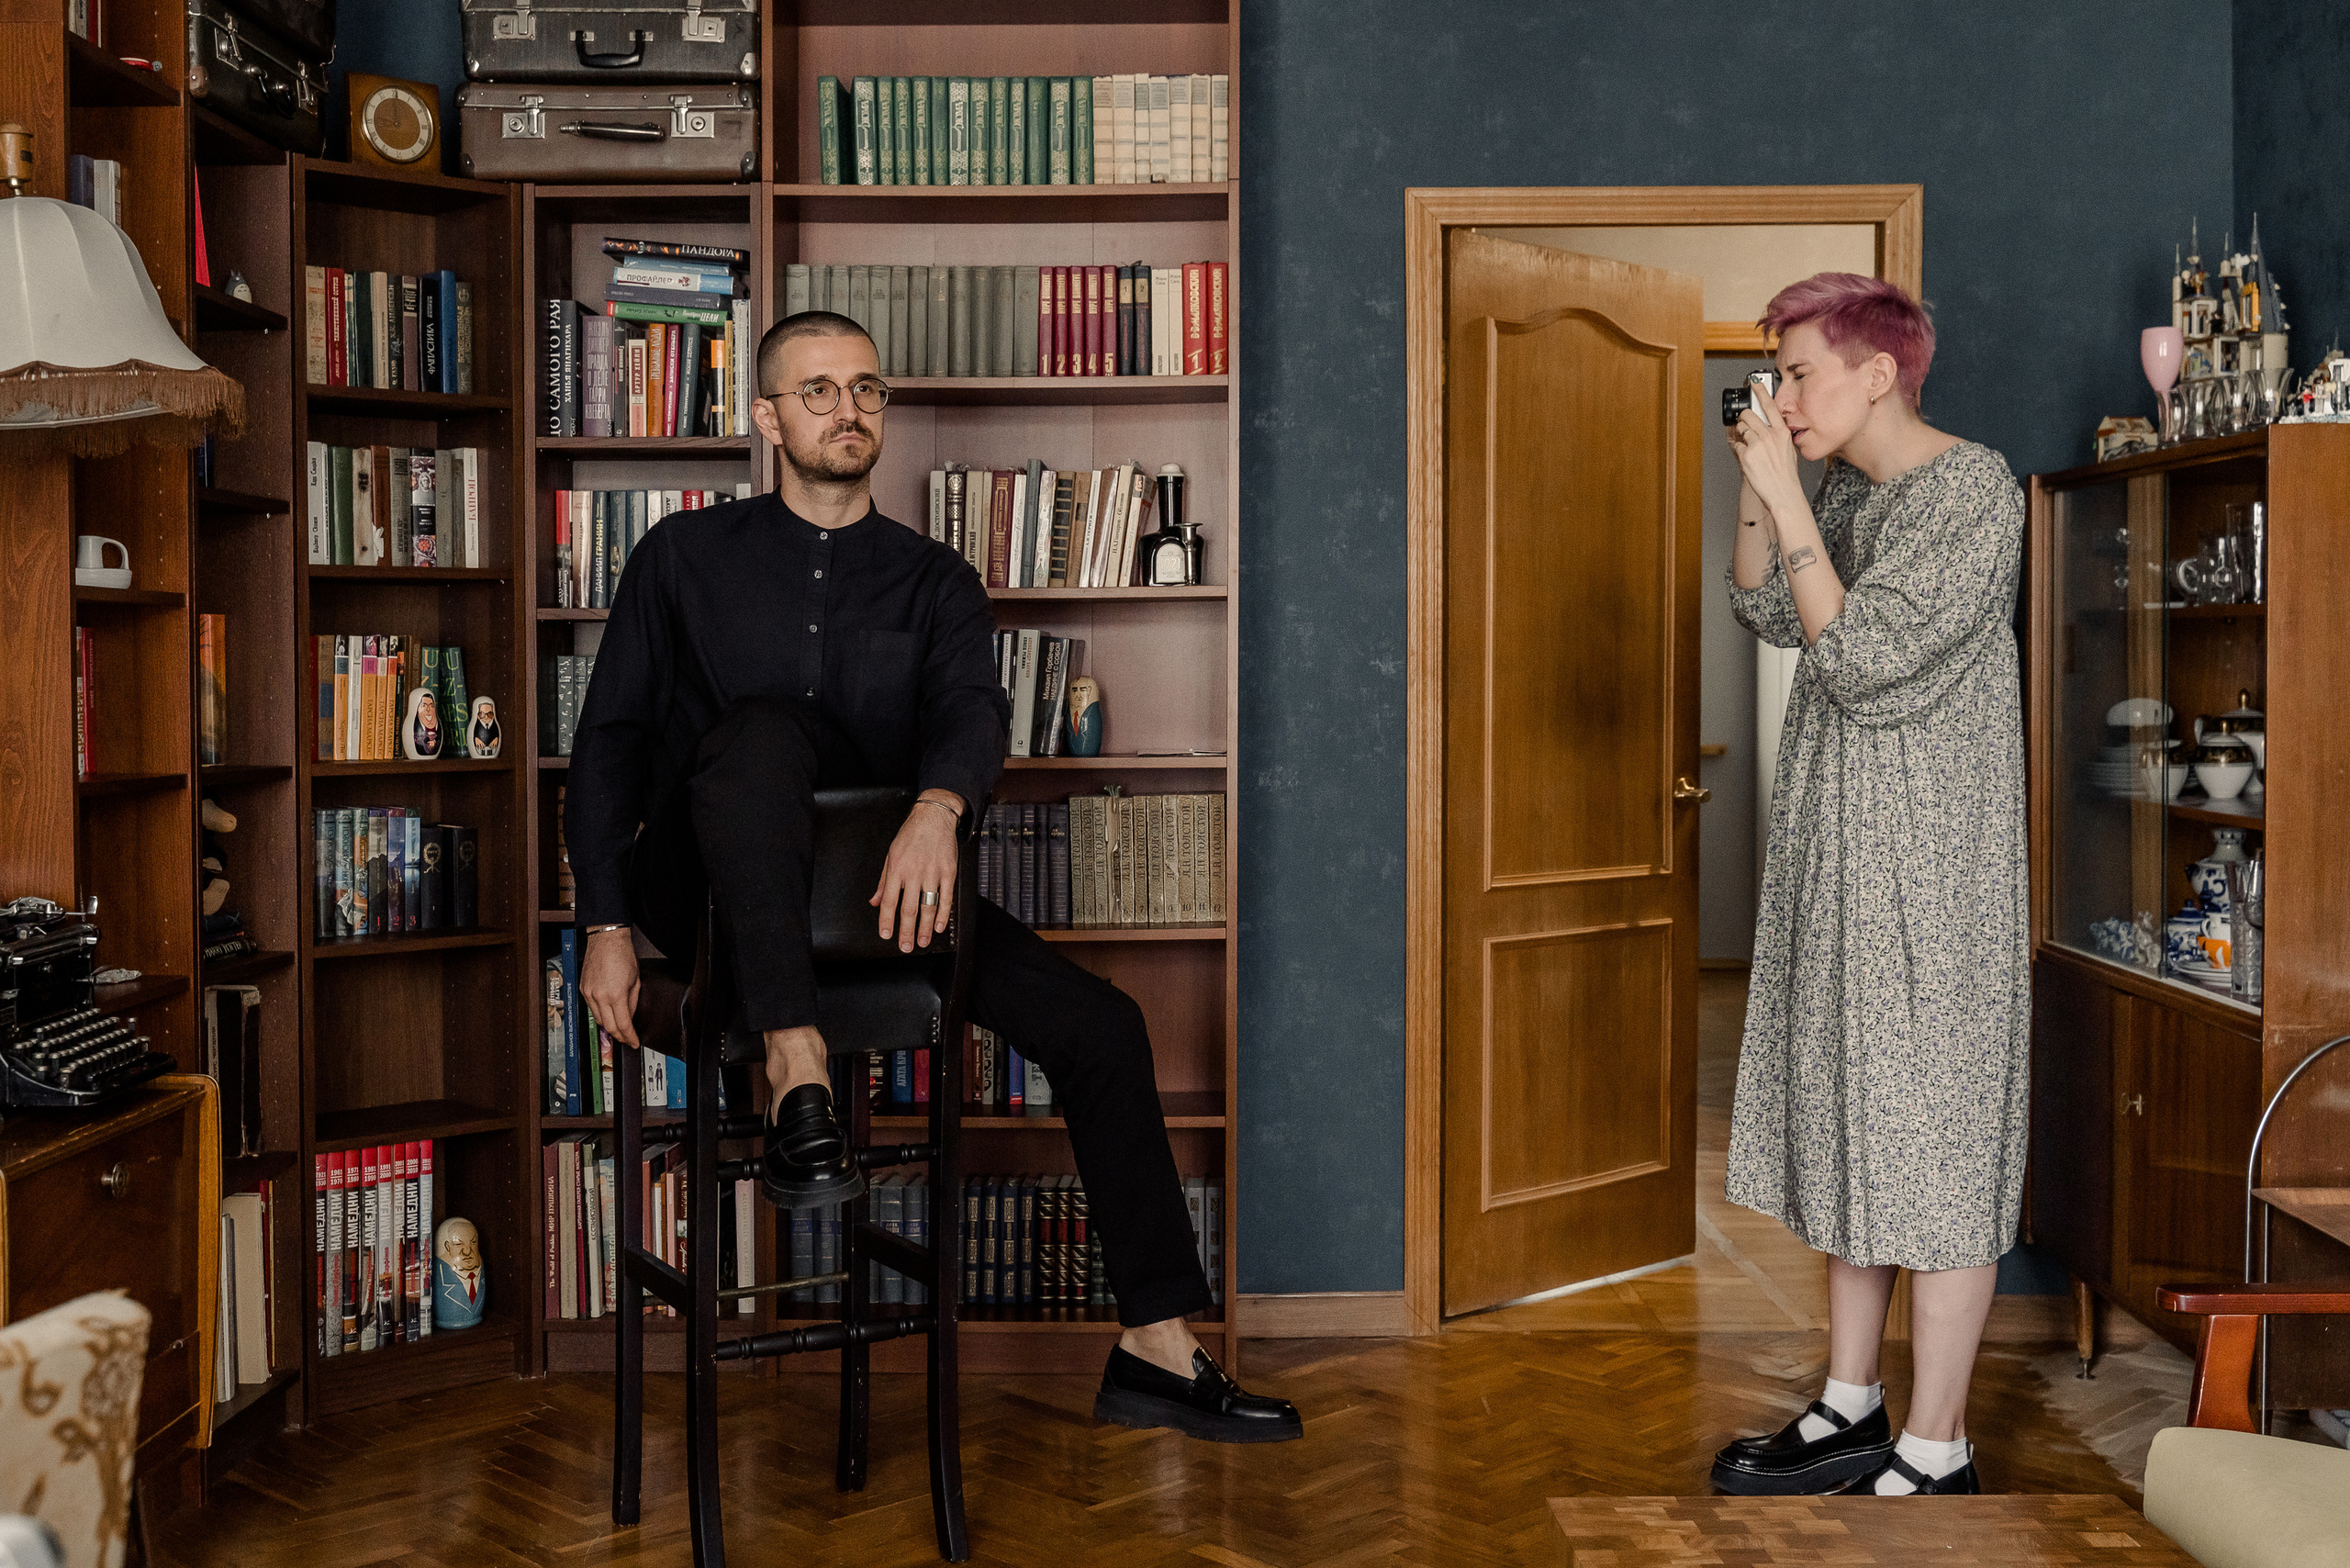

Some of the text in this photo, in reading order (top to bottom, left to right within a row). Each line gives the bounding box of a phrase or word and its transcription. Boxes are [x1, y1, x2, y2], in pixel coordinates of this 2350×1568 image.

[681, 245, 734, 259] ПАНДОРА
[627, 274, 673, 286] ПРОФАЙЛЕР
[550, 298, 561, 330] РАЯ
[699, 311, 720, 324] ЦЕЛИ
[426, 323, 436, 375] ФАНТАСТИКА
[650, 329, 661, 380] ТРЕВОЖНЫЕ ЛЮДИ
[550, 335, 561, 410] САМОГО
[633, 348, 643, 394] АРТУР ХЕЙЛИ
[1042, 354, 1048, 375] 1
[1057, 354, 1066, 375] 2
[1072, 353, 1081, 374] 3
[1088, 353, 1097, 374] 4
[1104, 353, 1113, 370] 5
[588, 387, 607, 402] ГАРРИ
[586, 405, 610, 420] КВЕБЕРТА
[467, 479, 476, 521] БАЙРОН
[1116, 493, 1125, 515] Обломов
[595, 519, 604, 593] ДАНИИЛ ГРАНИН
[1043, 673, 1051, 700] Михаил
[365, 699, 374, 756] ГАРСИА МАРКЕС
[386, 727, 395, 756] МАРКЕС
[409, 915, 417, 926] 3
[222, 940, 242, 954] POTTER
[896, 1066, 907, 1087] АГАТА
[347, 1175, 359, 1183] 1980
[364, 1174, 376, 1182] 1990
[606, 1169, 615, 1197] ДЕТЕЙ
[347, 1191, 359, 1248] НАМЕДНИ
[364, 1189, 377, 1247] НАМЕДНИ
[407, 1182, 419, 1238] НАМЕДНИ
[330, 1193, 343, 1250] НАМЕДНИ
